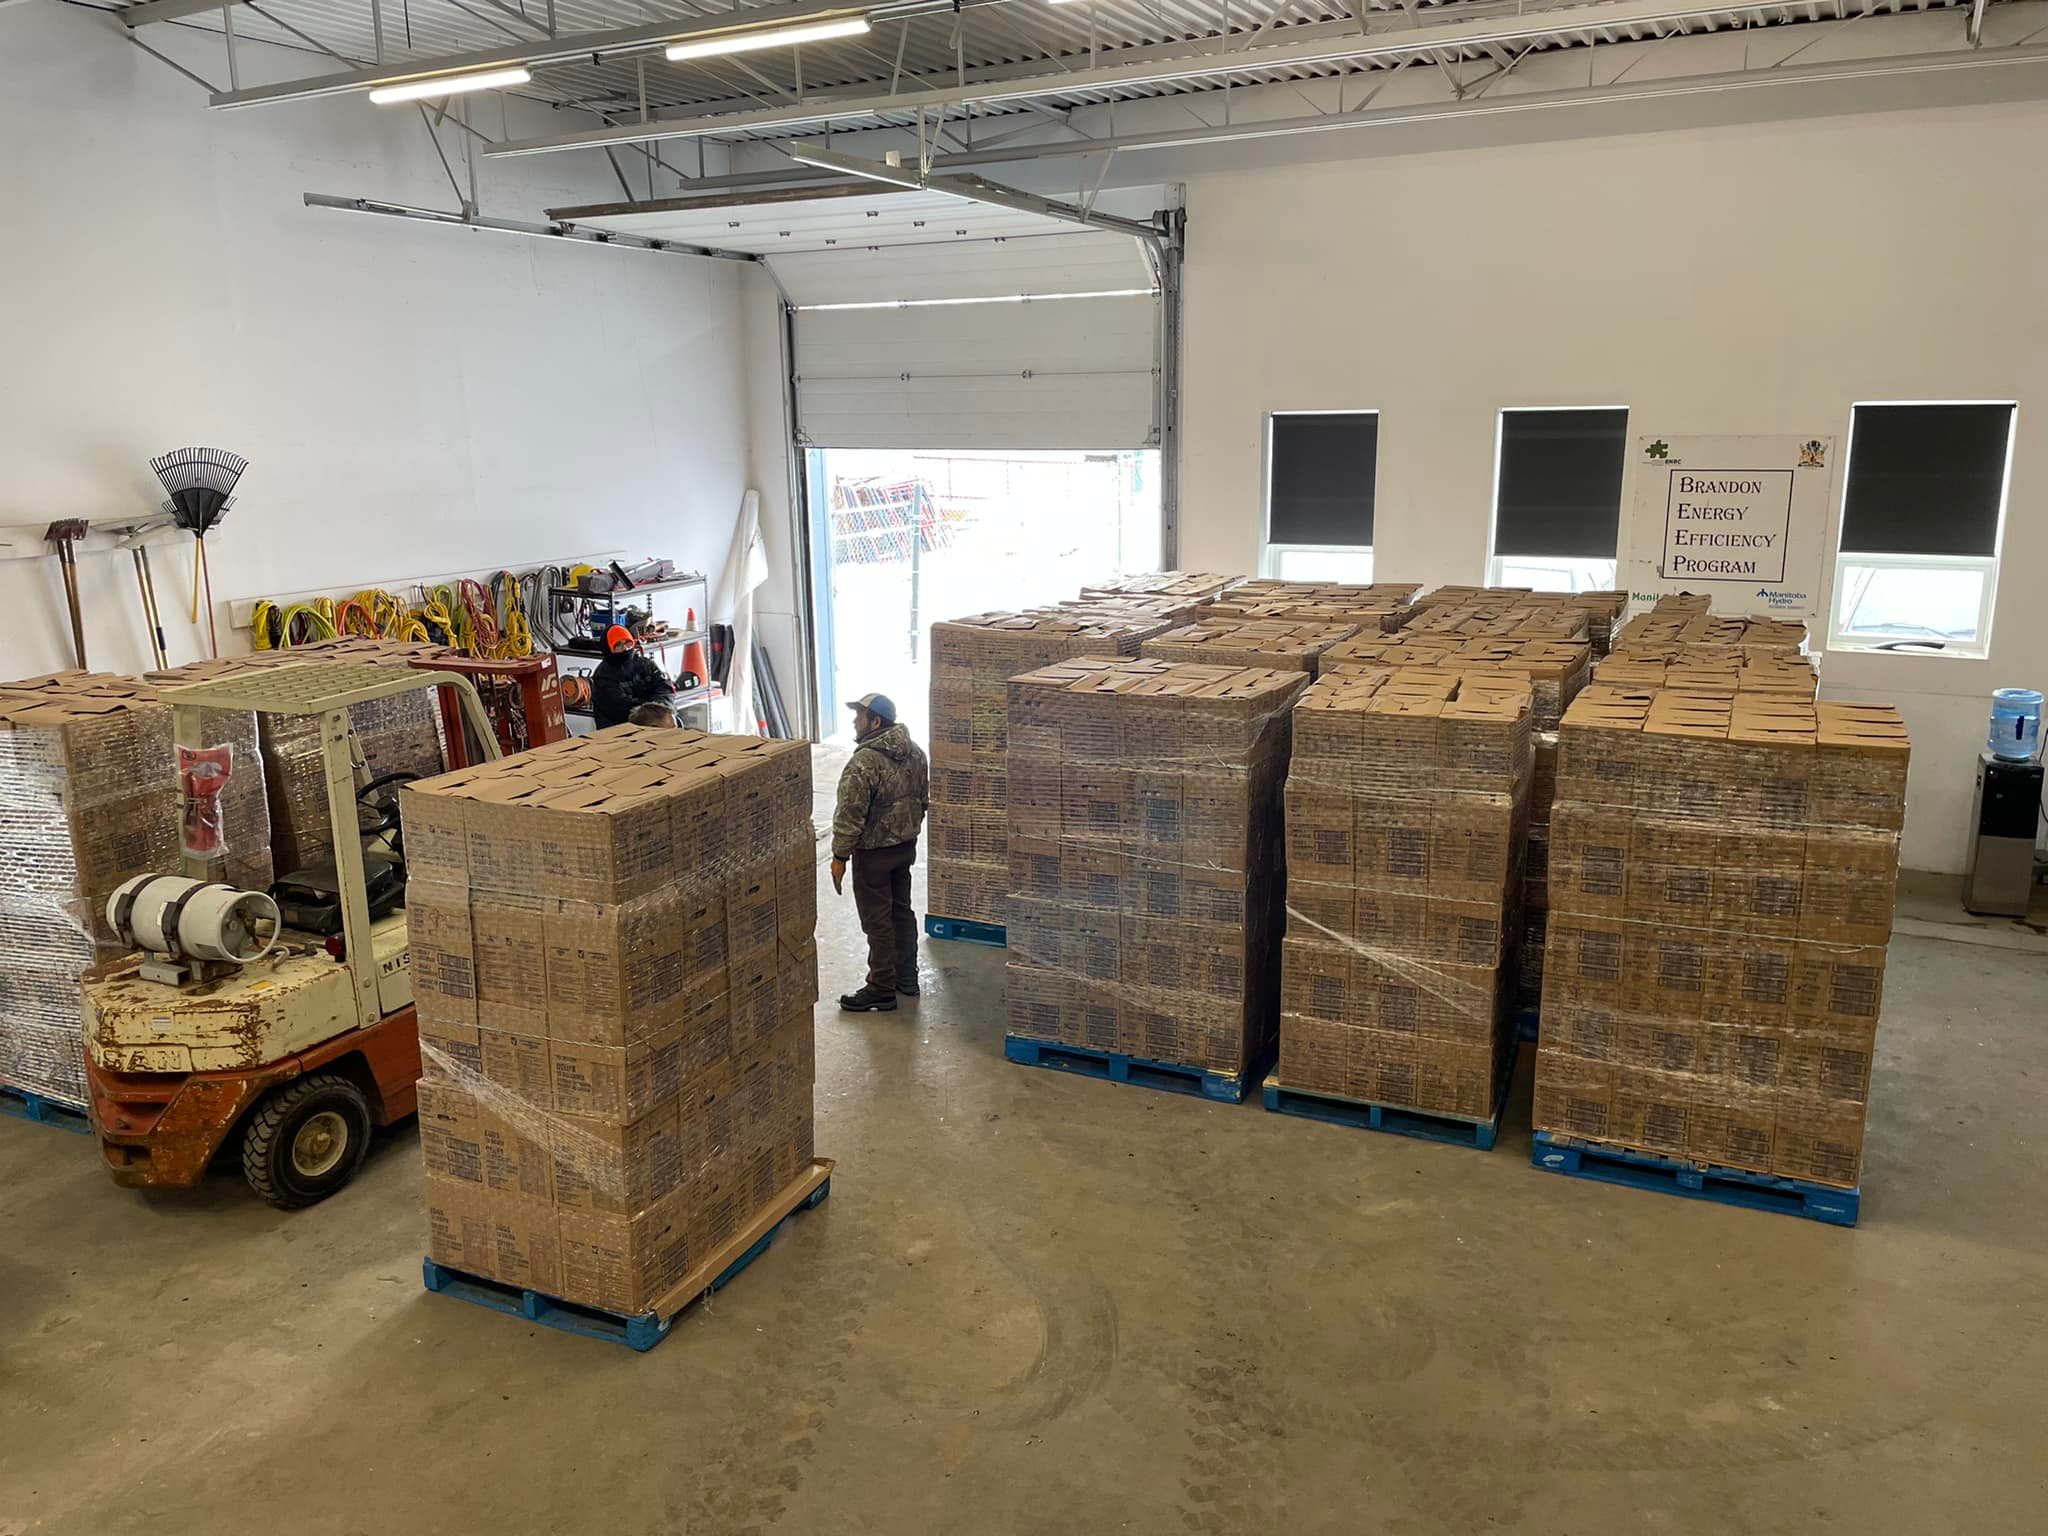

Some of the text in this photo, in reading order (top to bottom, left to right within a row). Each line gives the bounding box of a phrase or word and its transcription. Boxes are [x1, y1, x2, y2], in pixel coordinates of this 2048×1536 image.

[1680, 477, 1762, 493] BRANDON
[1678, 503, 1749, 520] ENERGY
[1675, 529, 1776, 547] EFFICIENCY
[1673, 555, 1756, 573] PROGRAM
[1769, 591, 1807, 599] Manitoba
